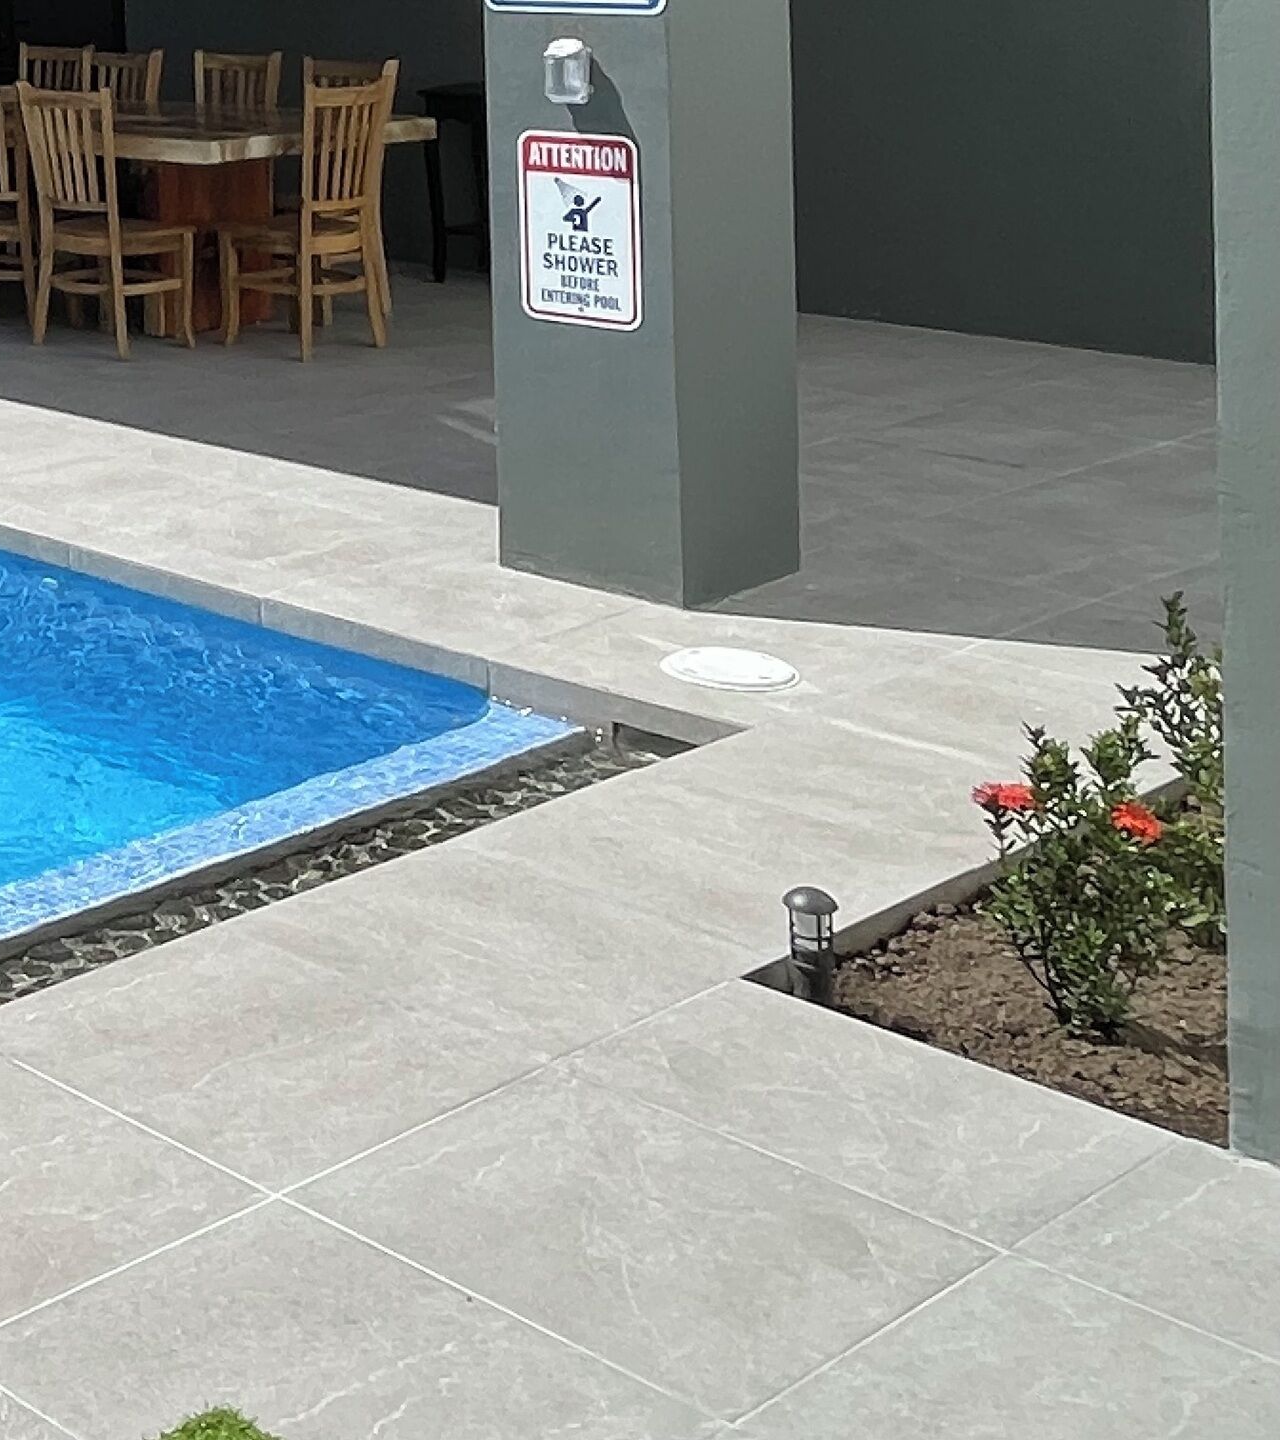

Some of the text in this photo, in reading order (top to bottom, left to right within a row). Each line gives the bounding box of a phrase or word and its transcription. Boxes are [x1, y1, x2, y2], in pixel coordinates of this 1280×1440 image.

[528, 141, 628, 173] ATTENTION
[547, 233, 614, 256] PLEASE
[543, 253, 619, 278] SHOWER
[560, 275, 600, 292] BEFORE
[541, 288, 622, 312] ENTERING POOL
